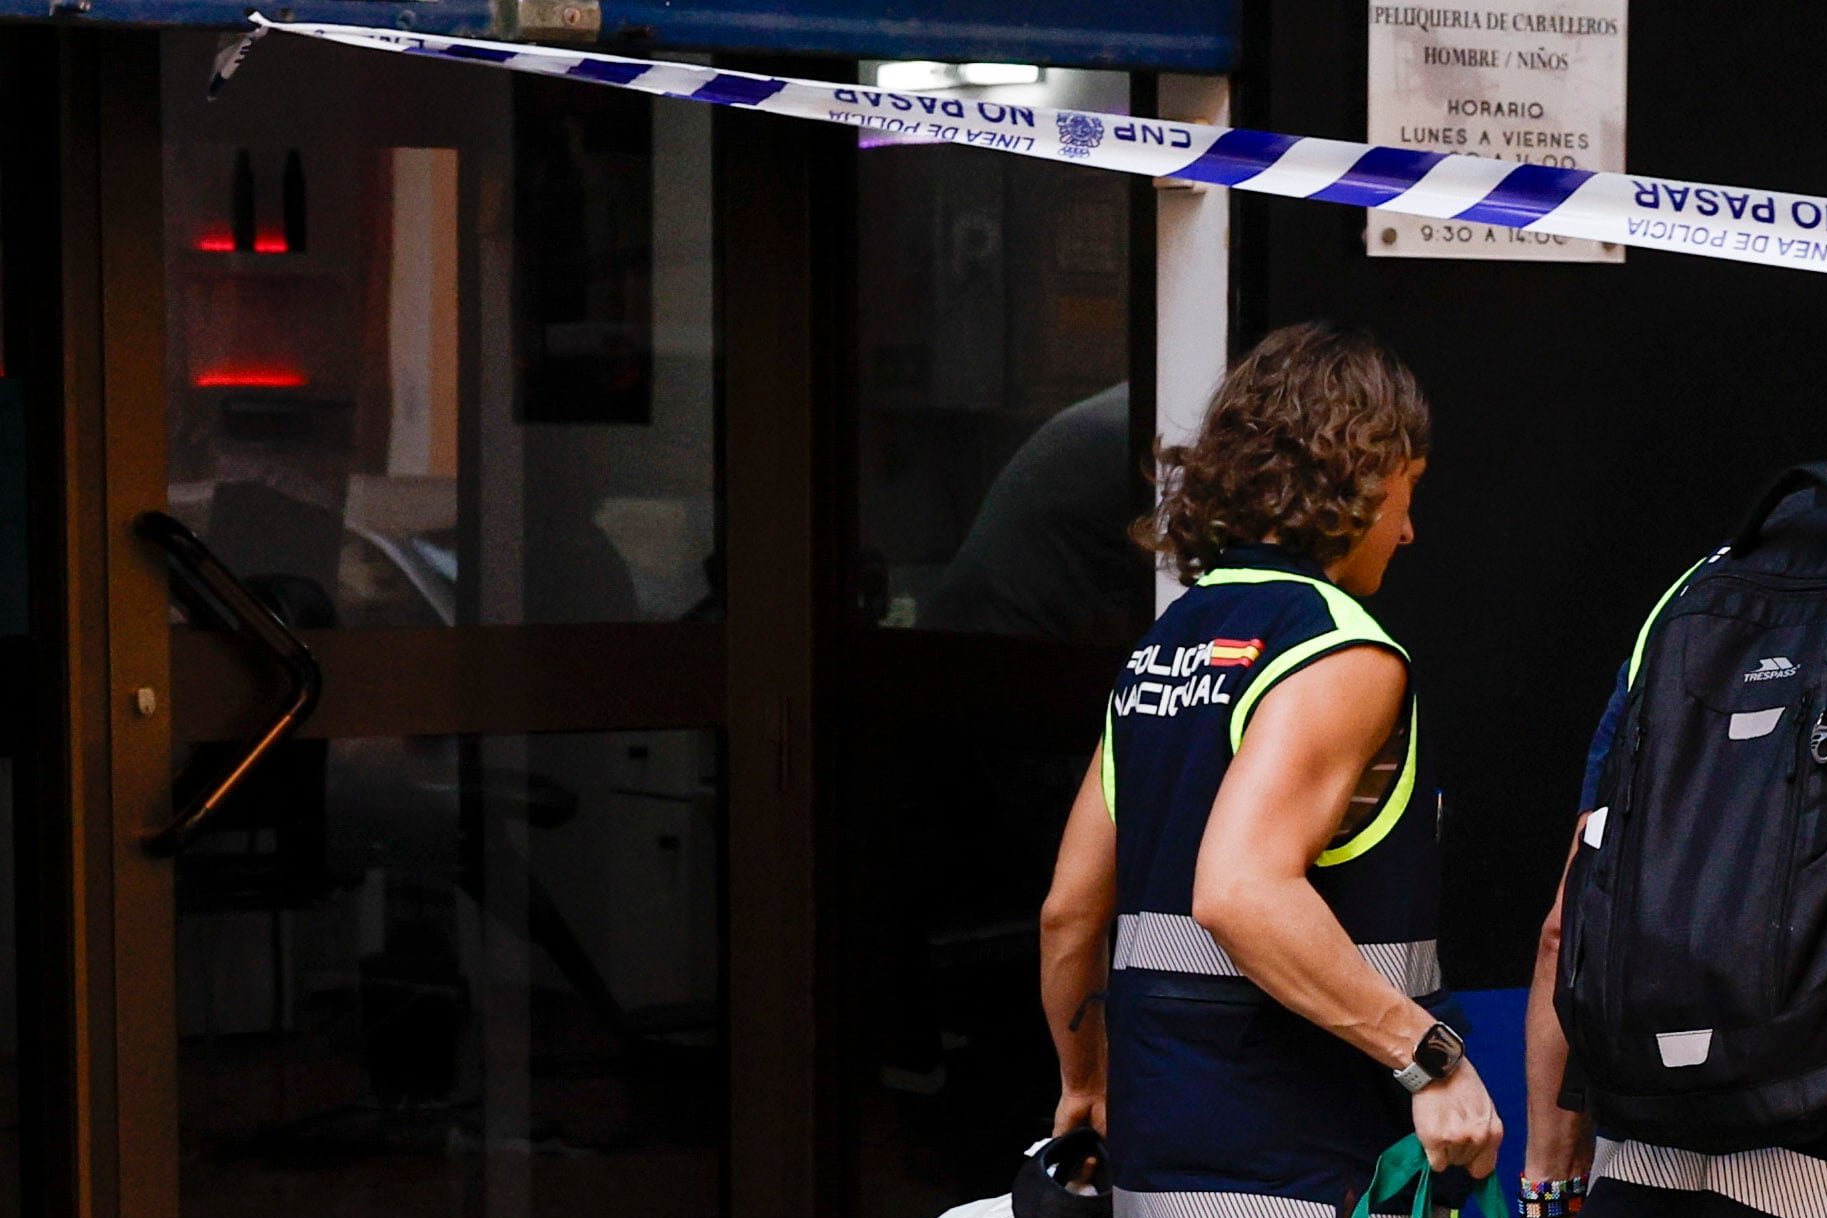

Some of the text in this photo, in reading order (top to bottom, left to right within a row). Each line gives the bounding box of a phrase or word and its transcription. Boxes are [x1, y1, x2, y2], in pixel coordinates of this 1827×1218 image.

[1374, 6, 1618, 35] PELUQUERIA DE CABALLEROS
[1424, 46, 1499, 68] HOMBRE
[1517, 47, 1569, 71] NIÑOS
[834, 88, 1035, 127] NO PASAR
[1447, 99, 1544, 120] HORARIO
[928, 123, 958, 142] DE
[967, 129, 1035, 151] LINEA
[1113, 125, 1192, 148] CNP
[1400, 125, 1590, 150] LUNES A VIERNES
[1631, 179, 1775, 224] PASAR
[1420, 224, 1472, 243] 9:30
[1484, 227, 1496, 243] A
[1626, 216, 1729, 248] POLICIA
[1733, 231, 1769, 254] DE
[1743, 668, 1797, 683] TRESPASS
